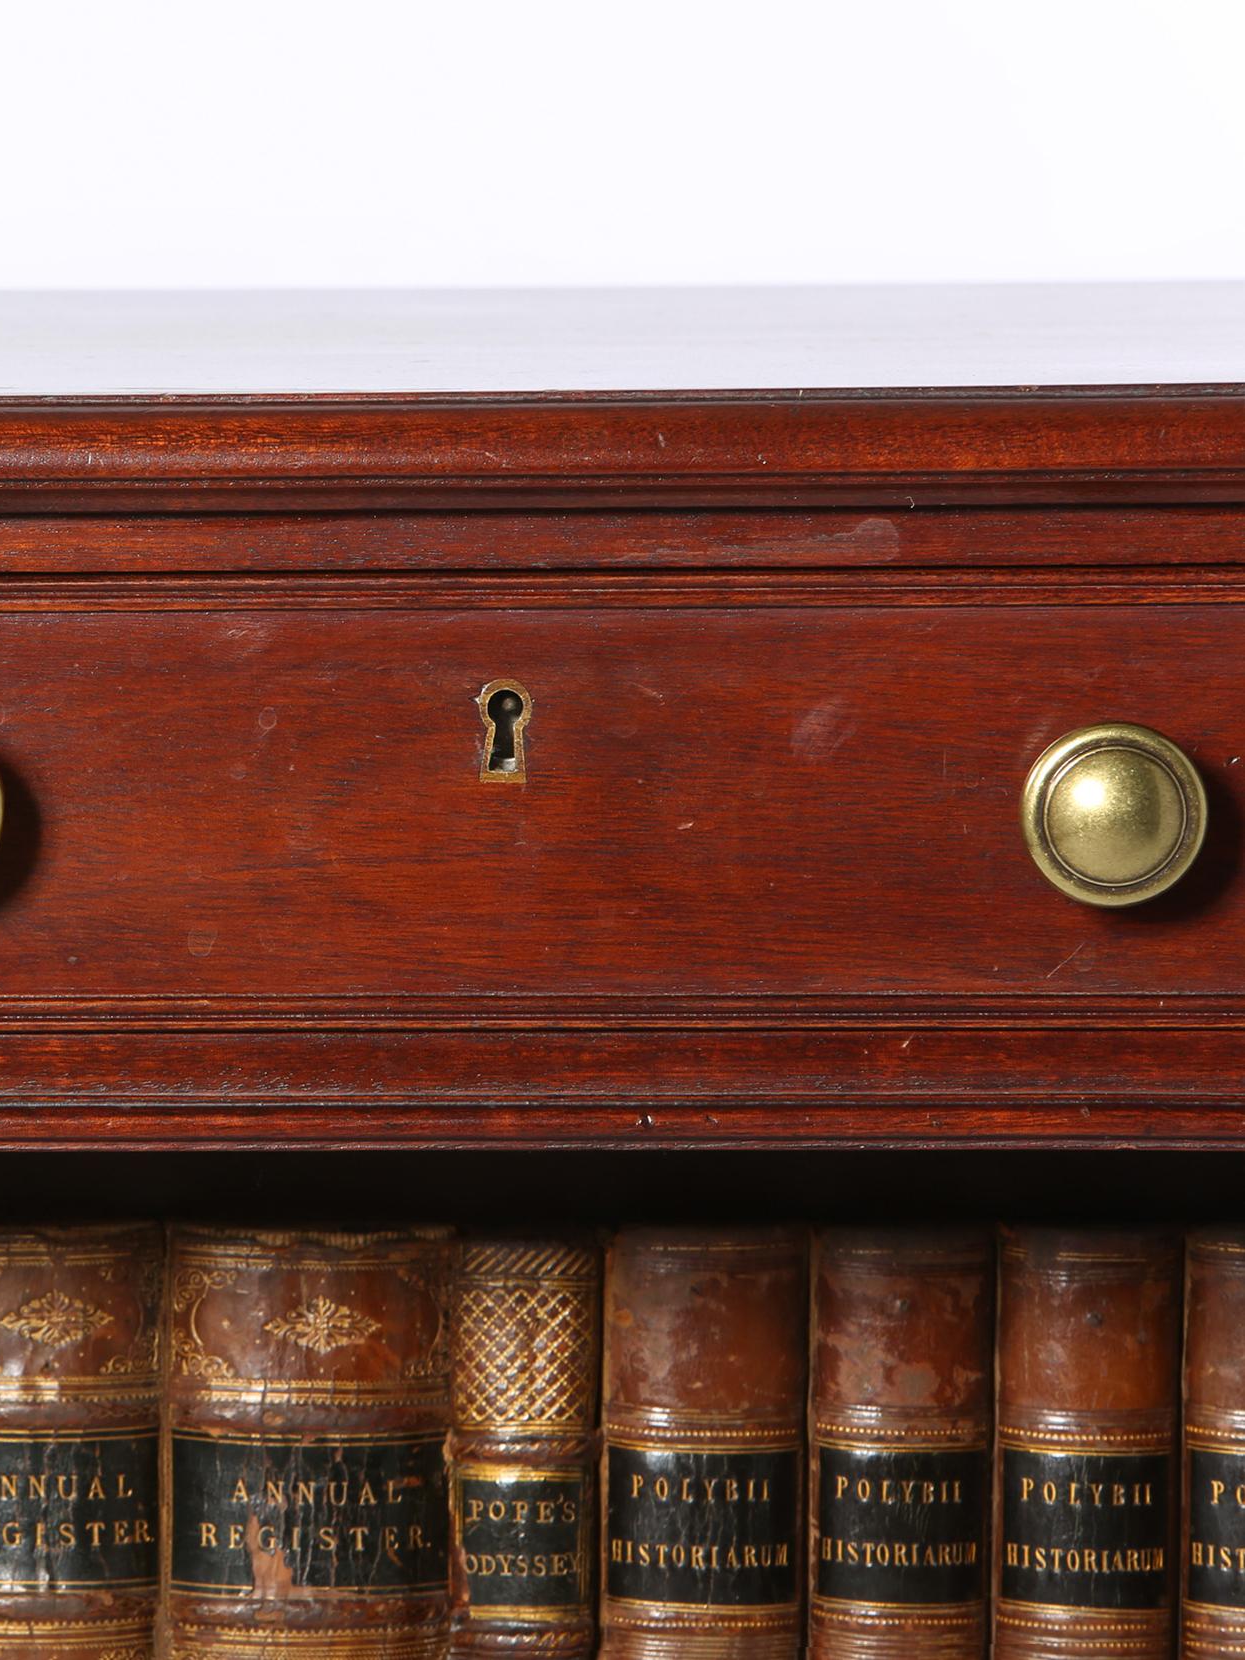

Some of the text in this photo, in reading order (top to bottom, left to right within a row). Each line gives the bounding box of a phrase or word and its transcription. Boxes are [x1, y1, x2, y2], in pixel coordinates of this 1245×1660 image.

[232, 1478, 403, 1506] ANNUAL
[630, 1473, 771, 1503] POLYBII
[835, 1475, 961, 1504] POLYBII
[1021, 1477, 1153, 1507] POLYBII
[466, 1493, 576, 1524] POPE'S
[465, 1553, 582, 1577] ODYSSEY
[612, 1538, 789, 1570] HISTORIARUM
[821, 1536, 977, 1567] HISTORIARUM
[1006, 1543, 1164, 1573] HISTORIARUM
